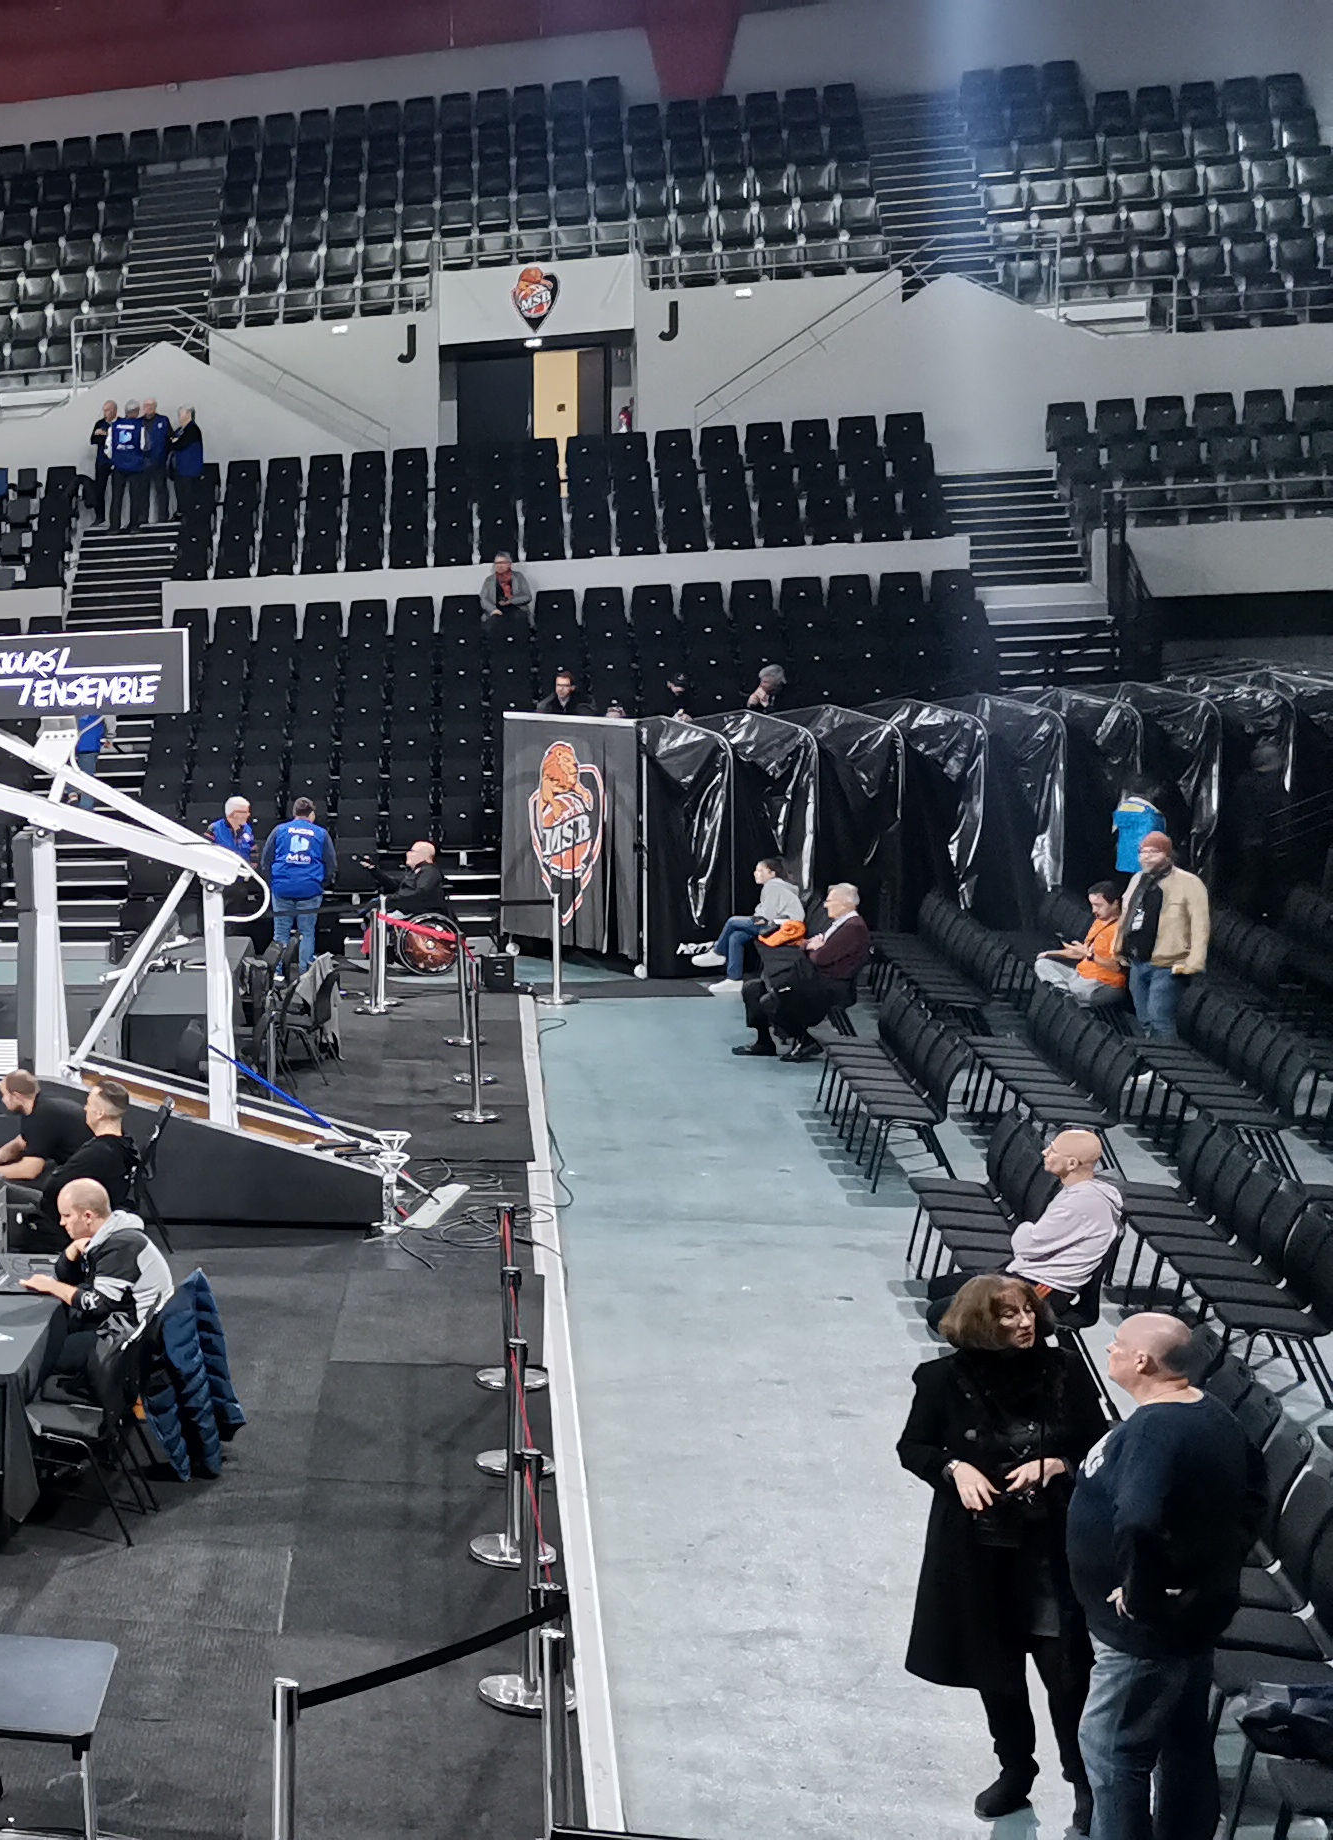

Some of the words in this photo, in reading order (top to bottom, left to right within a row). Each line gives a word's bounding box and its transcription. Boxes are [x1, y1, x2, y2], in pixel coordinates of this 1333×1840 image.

[521, 290, 551, 312] MSB
[658, 301, 679, 341] J
[397, 324, 416, 364] J
[32, 675, 162, 709] ENSEMBLE
[541, 813, 591, 856] MSB
